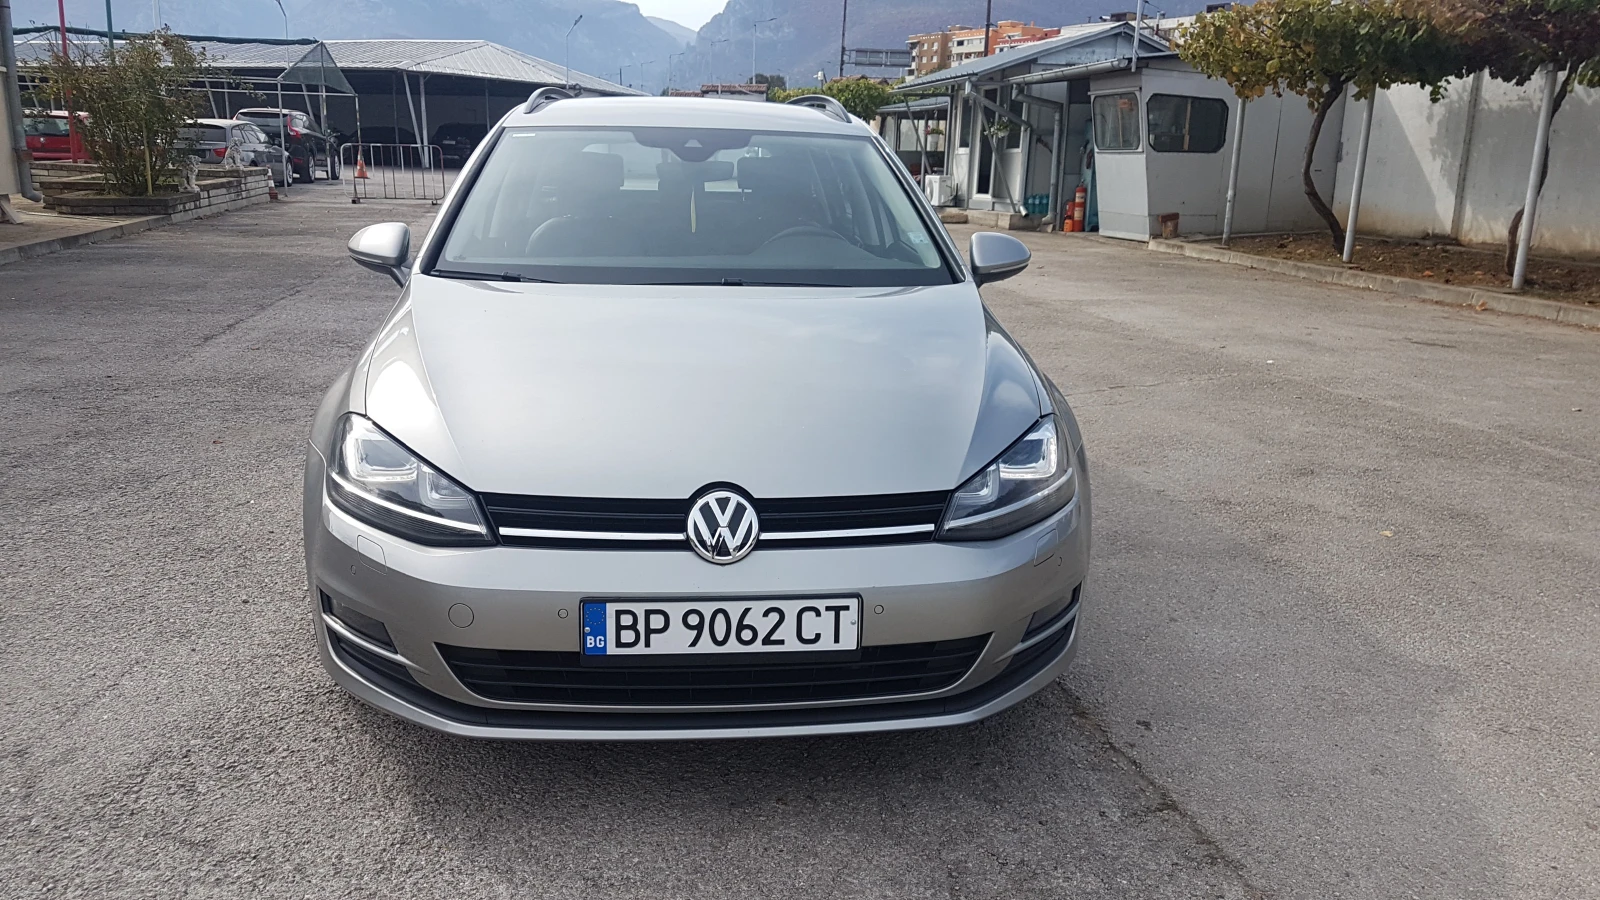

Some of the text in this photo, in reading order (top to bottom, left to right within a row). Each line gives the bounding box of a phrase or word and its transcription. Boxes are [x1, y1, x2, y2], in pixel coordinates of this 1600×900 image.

[690, 492, 756, 561] VW
[586, 635, 605, 648] BG
[614, 604, 851, 649] BP 9062 CT
